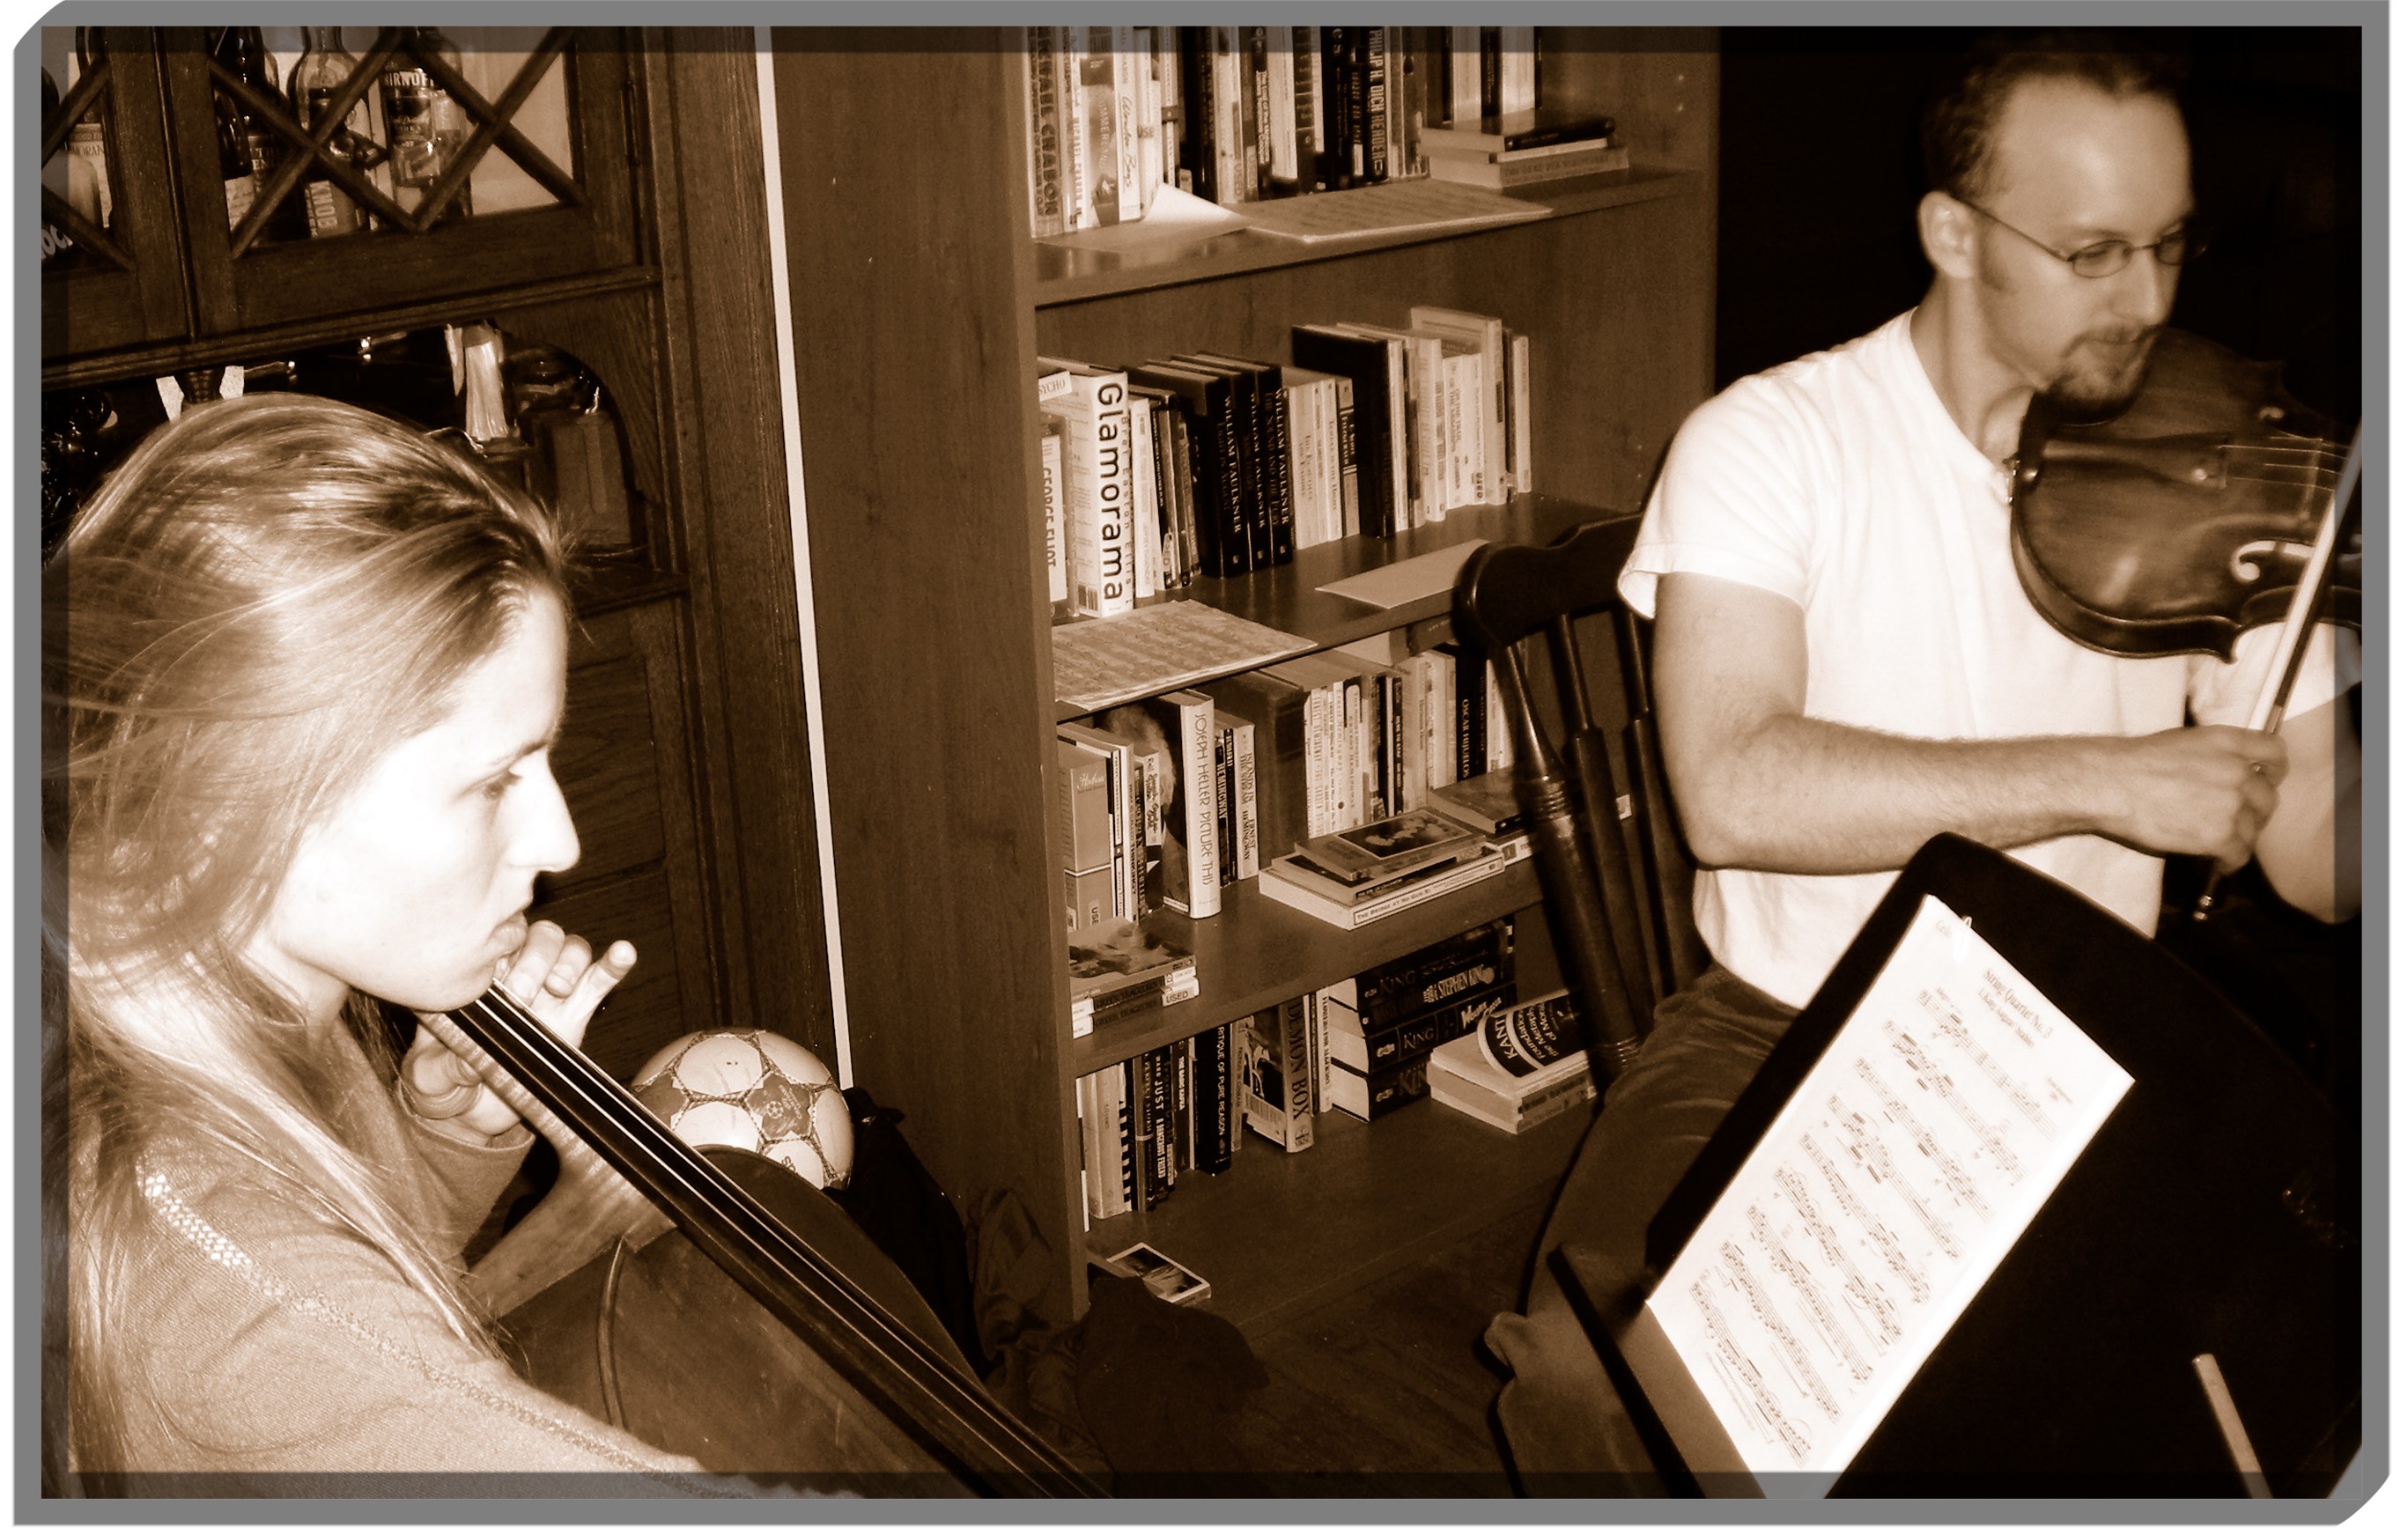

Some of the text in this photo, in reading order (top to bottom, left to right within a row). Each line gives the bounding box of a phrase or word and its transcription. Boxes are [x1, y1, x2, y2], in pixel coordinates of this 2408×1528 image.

[1369, 29, 1384, 69] PHILIP
[1370, 114, 1386, 159] READER
[309, 179, 339, 229] KNOB
[1038, 378, 1067, 397] SYCHO
[1223, 395, 1243, 535] WILLIAM FAULKNER
[1250, 394, 1267, 529] WILLIAM FAULKNER
[1274, 388, 1290, 526] WILLIAM FAULKNER
[1097, 381, 1125, 601] Glamorama
[1461, 698, 1471, 779] OSCAR HIJUELOS
[1194, 712, 1215, 886] JOSEPH HELLER PICTURE THIS
[1215, 762, 1227, 821] HEMINGWAY
[1248, 818, 1257, 850] ERNEST
[1165, 990, 1190, 1004] USED
[1437, 972, 1469, 999] STEPHEN
[1983, 969, 2056, 1040] String Quartet No. 3
[1404, 1027, 1435, 1049] KING
[1494, 1018, 1519, 1059] KANT
[1218, 1061, 1225, 1074] OF
[1286, 1001, 1311, 1121] DEMON BOX
[1154, 1080, 1164, 1111] JUST
[1218, 1101, 1227, 1136] REASON
